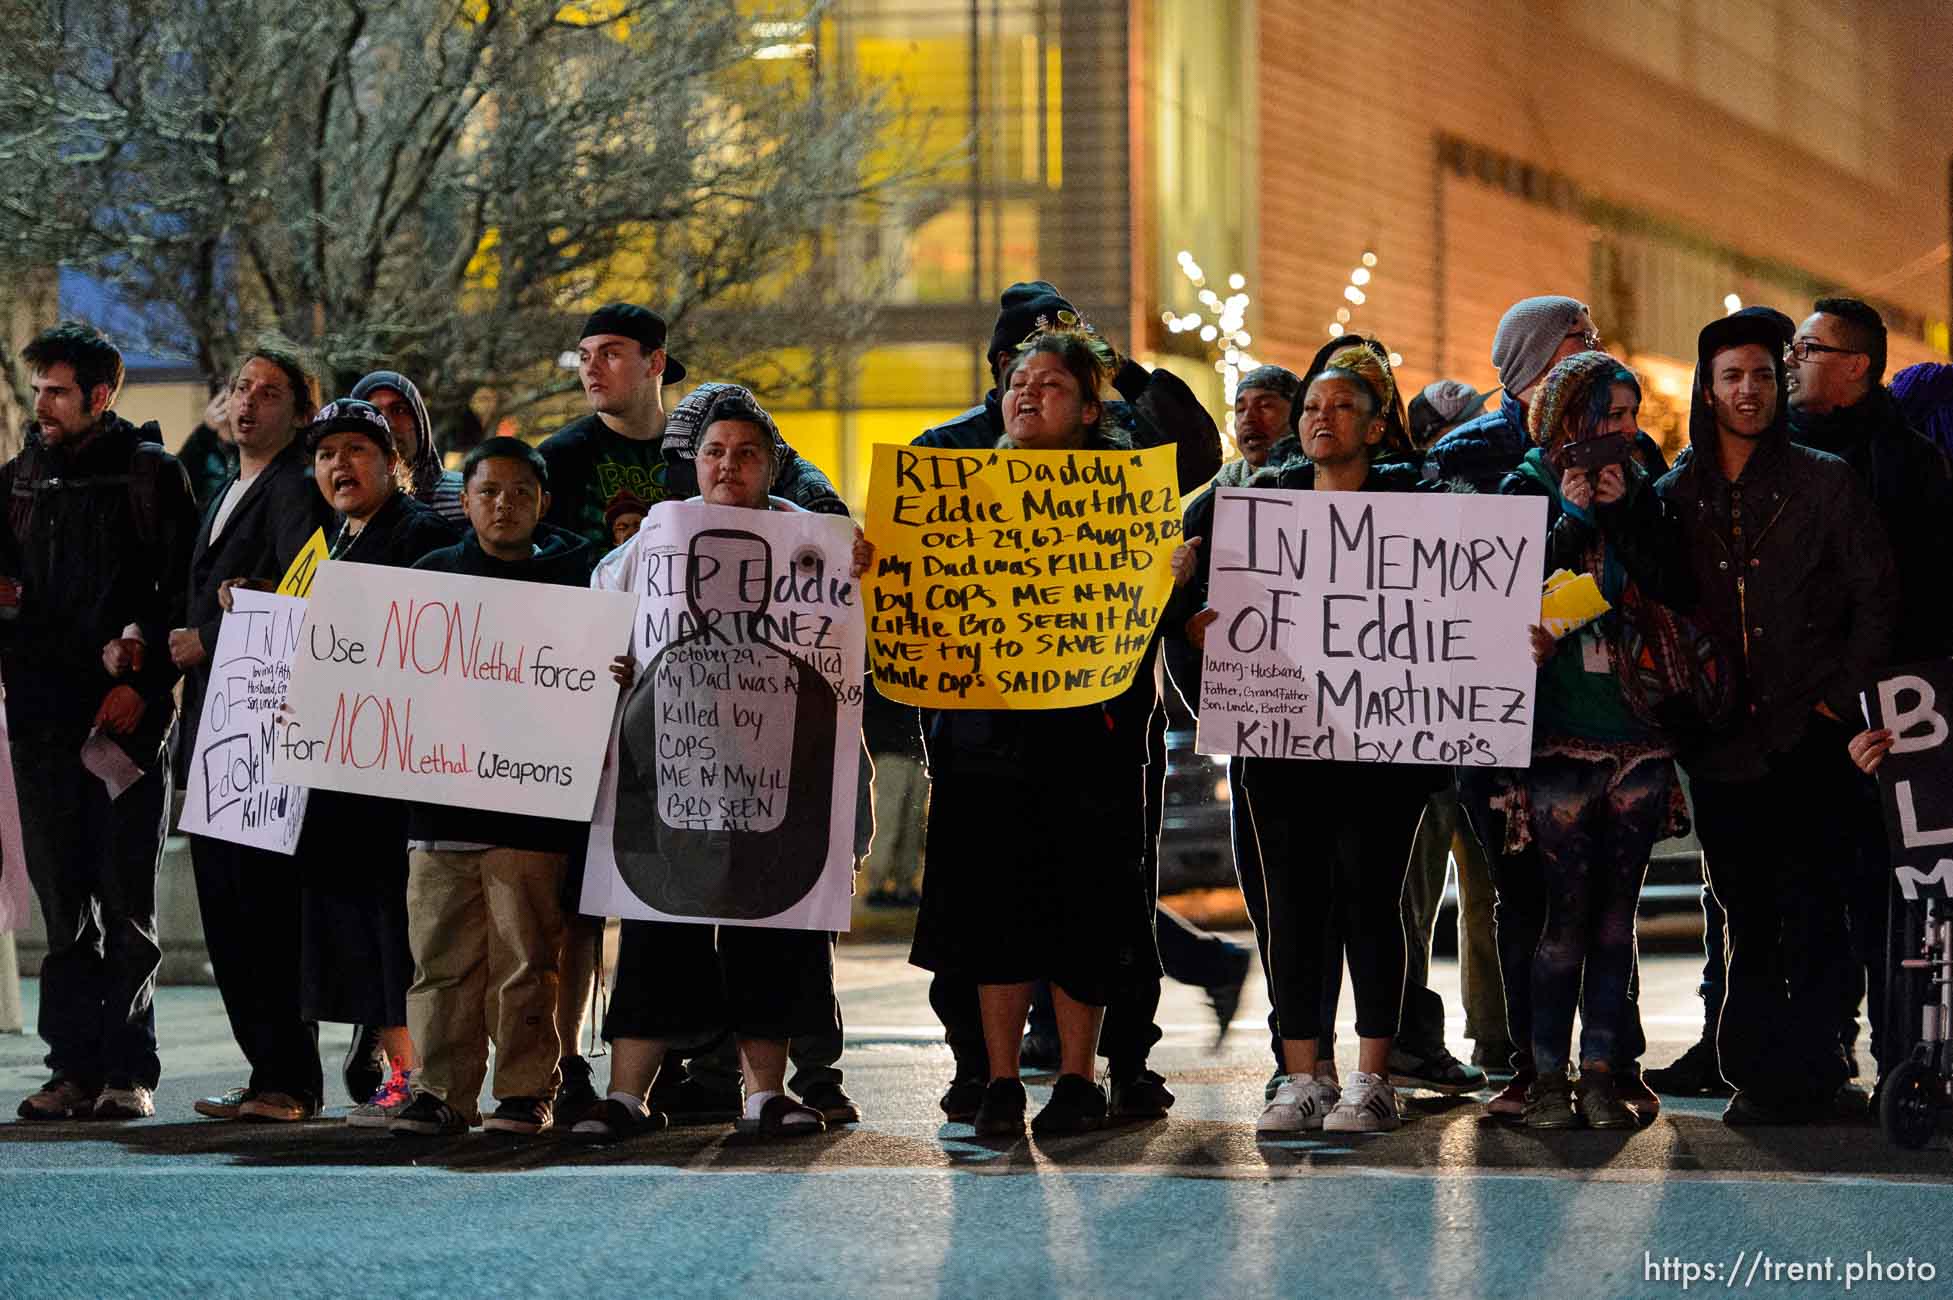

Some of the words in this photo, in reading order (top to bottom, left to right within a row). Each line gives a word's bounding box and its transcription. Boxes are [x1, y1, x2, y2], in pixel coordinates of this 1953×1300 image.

[896, 450, 983, 493] RIP
[892, 494, 1014, 527] Eddie
[1022, 487, 1177, 522] Martinez
[1216, 496, 1308, 581] IN
[1328, 504, 1529, 598] MEMORY
[647, 553, 721, 600] RIP
[739, 559, 855, 607] Eddie
[877, 554, 912, 587] My
[923, 554, 977, 577] Dad
[1048, 549, 1153, 577] KILLED
[873, 586, 913, 614] by
[1012, 584, 1065, 608] ME
[1103, 581, 1144, 610] My
[958, 613, 1006, 636] Bro
[1016, 610, 1088, 633] SEEN
[1227, 588, 1302, 654] OF
[310, 624, 367, 665] Use
[530, 645, 597, 692] force
[936, 641, 982, 674] try
[990, 640, 1024, 658] to
[1036, 633, 1109, 657] SAVE
[657, 664, 683, 697] My
[689, 662, 732, 690] Dad
[737, 673, 779, 694] was
[997, 668, 1061, 695] SAID
[663, 702, 721, 728] Killed
[733, 703, 763, 741] by
[1260, 702, 1308, 715] Brother
[280, 721, 325, 761] for
[477, 751, 573, 786] Weapons
[1353, 731, 1403, 764] by
[660, 763, 691, 788] ME
[666, 792, 712, 818] BRO
[718, 792, 774, 819] SEEN
